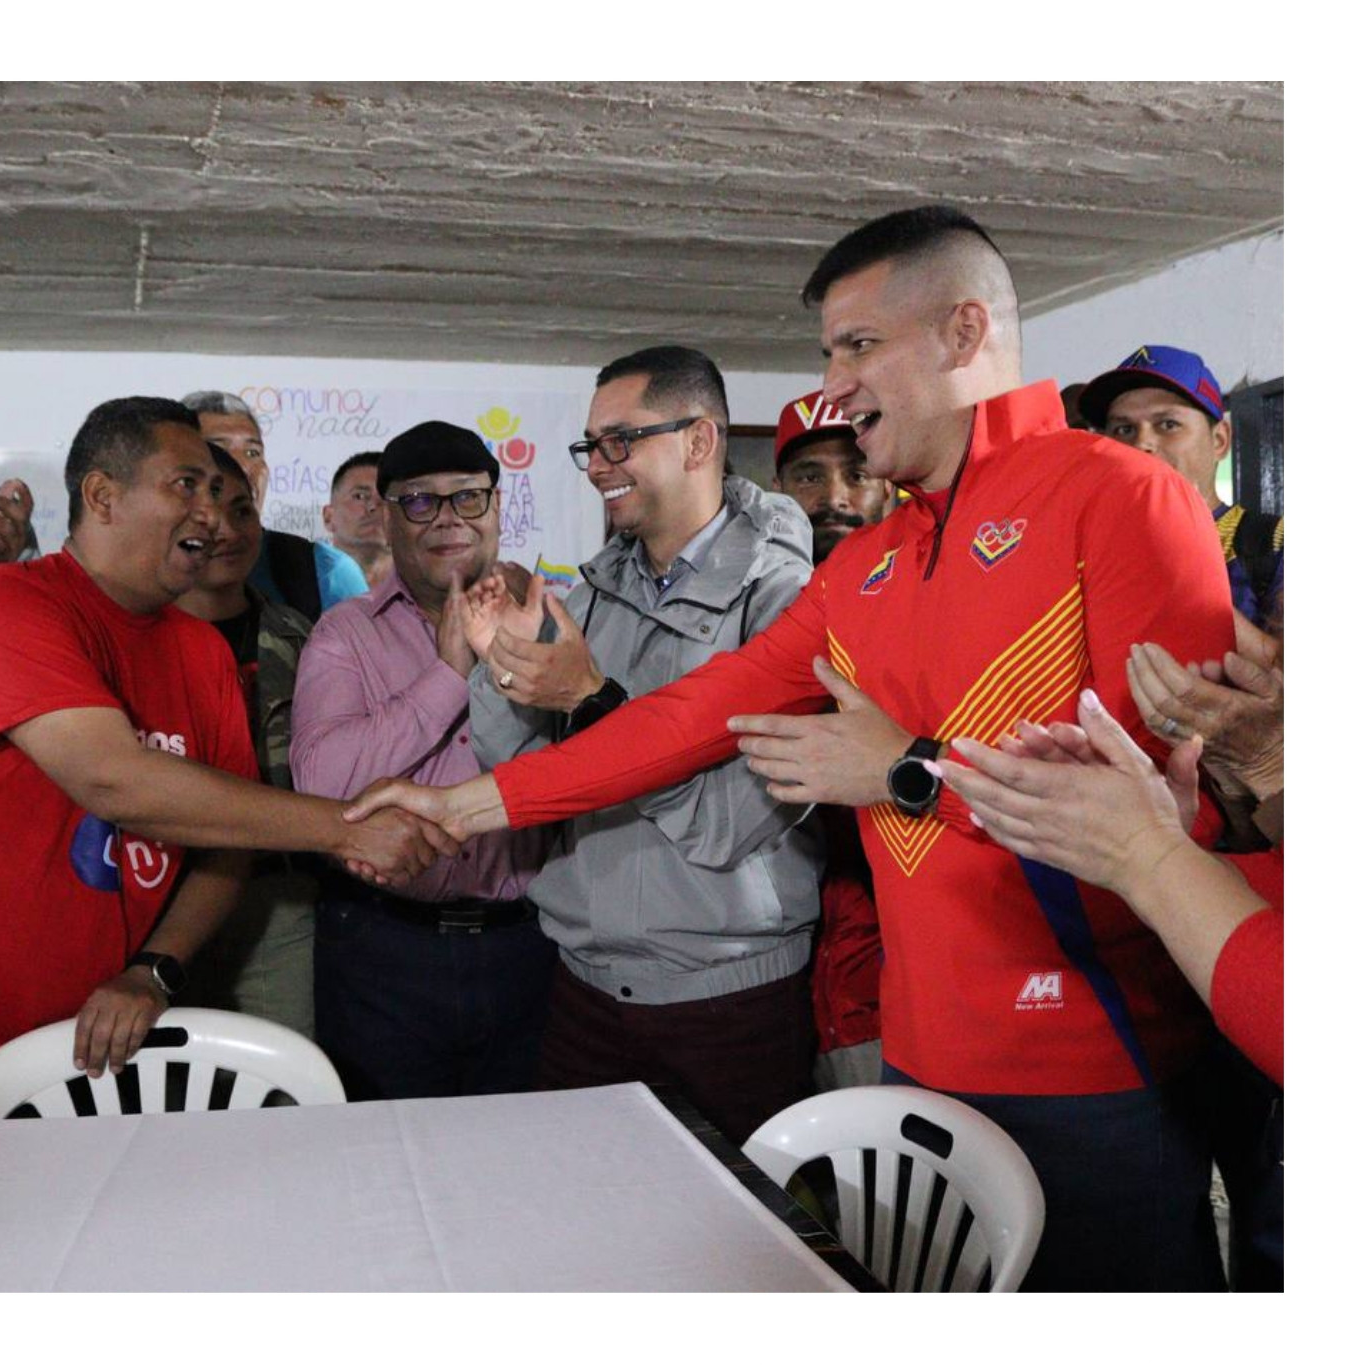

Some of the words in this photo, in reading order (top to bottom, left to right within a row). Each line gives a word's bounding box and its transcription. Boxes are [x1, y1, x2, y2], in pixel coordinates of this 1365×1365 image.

[296, 412, 390, 440] nada
[1015, 1002, 1034, 1011] New
[1035, 1001, 1064, 1011] Arrival
